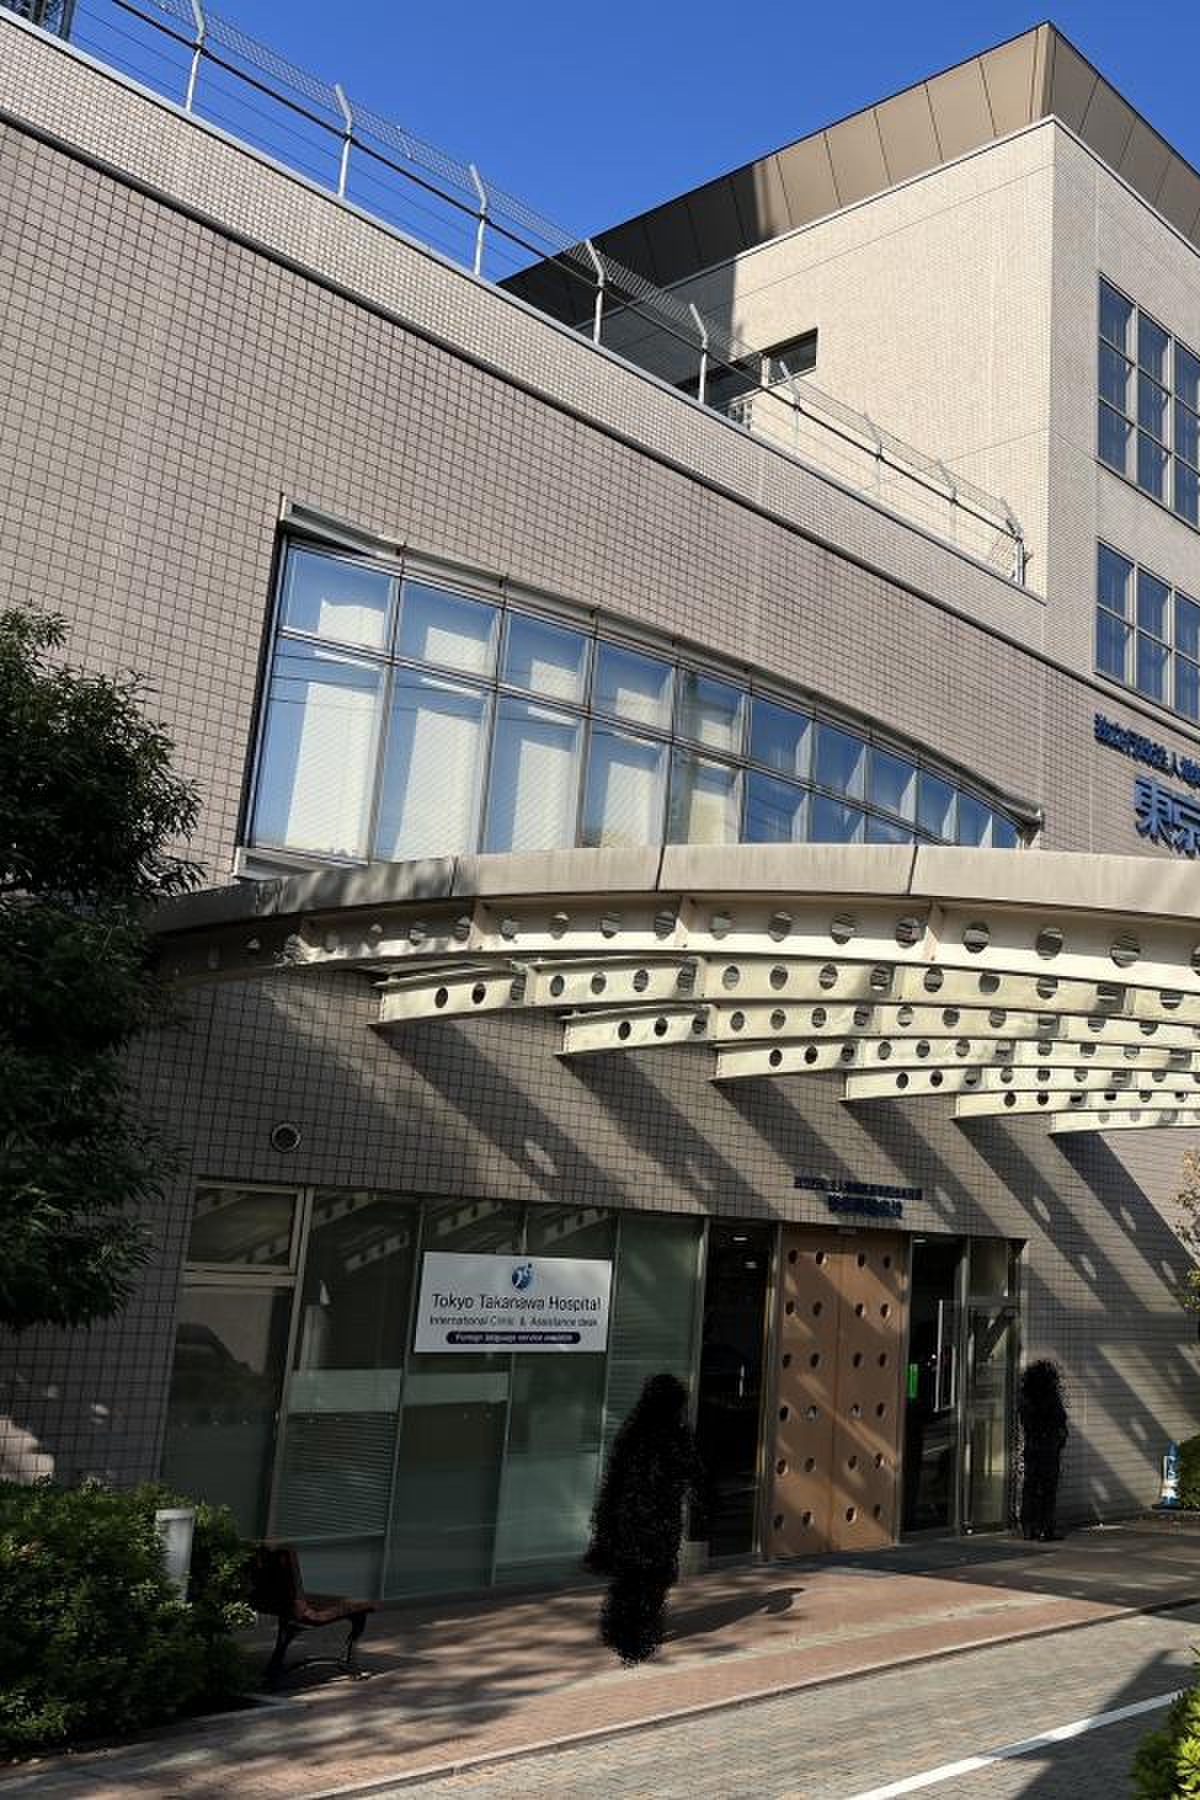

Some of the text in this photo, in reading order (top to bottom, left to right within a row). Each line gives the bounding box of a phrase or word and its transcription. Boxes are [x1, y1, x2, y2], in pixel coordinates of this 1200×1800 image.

[432, 1294, 601, 1312] Tokyo Takanawa Hospital
[429, 1315, 488, 1326] International
